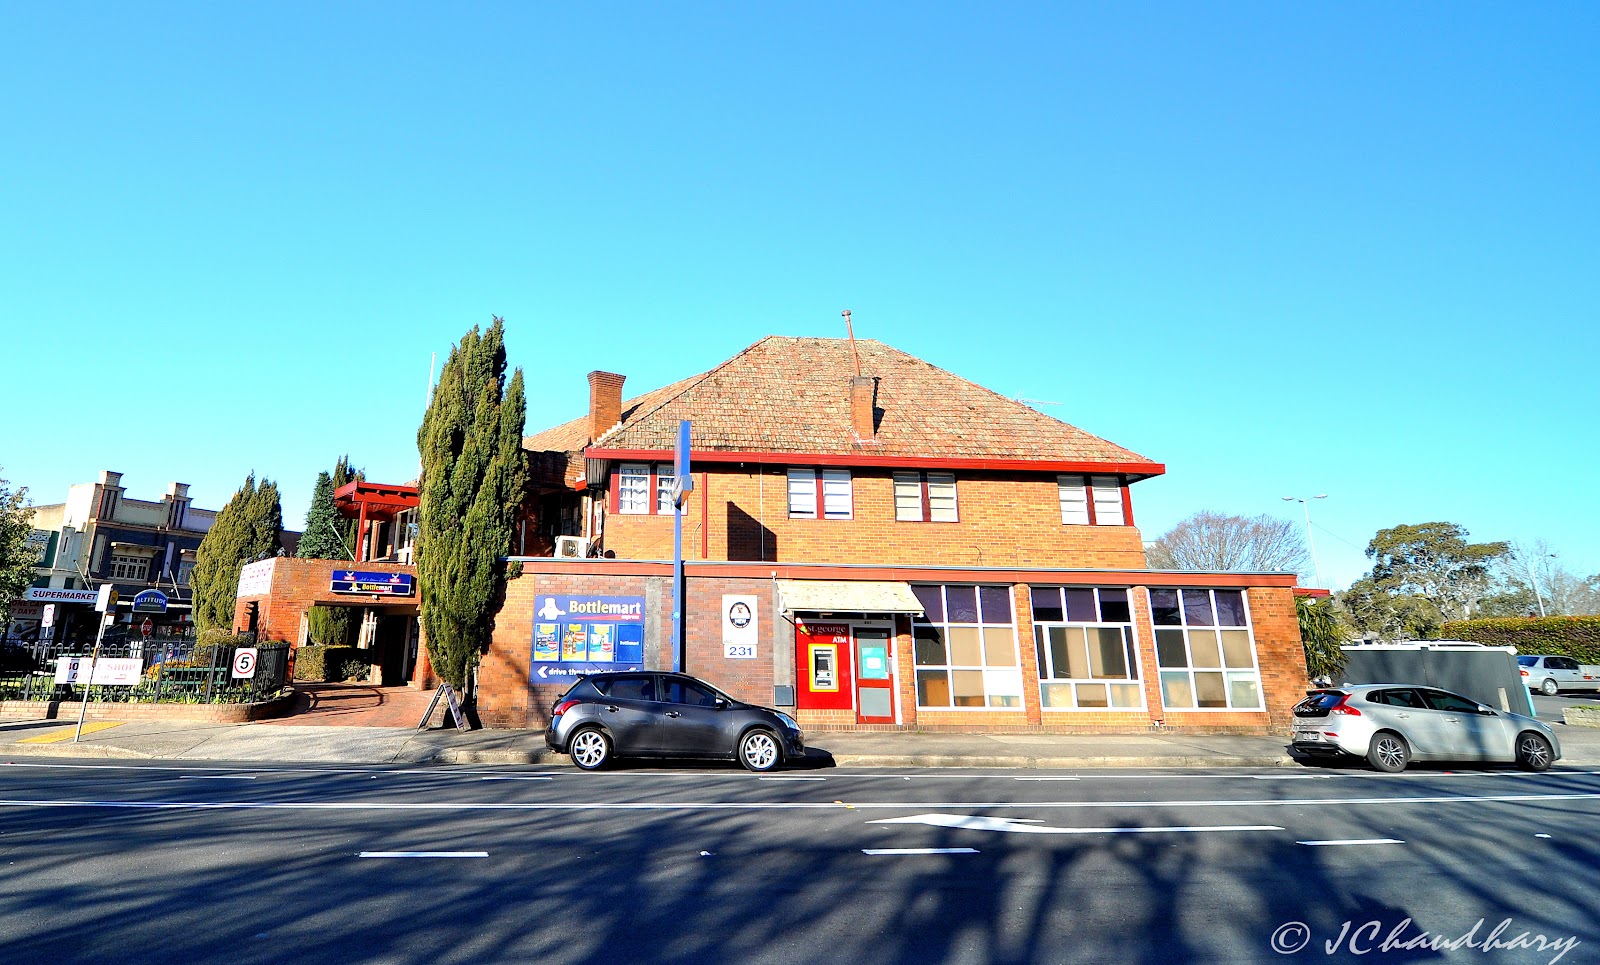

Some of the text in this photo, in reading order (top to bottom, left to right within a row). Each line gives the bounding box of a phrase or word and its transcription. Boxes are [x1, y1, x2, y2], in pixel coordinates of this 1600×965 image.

[361, 583, 393, 592] Bottlemart
[32, 590, 98, 600] SUPERMARKET
[136, 597, 167, 605] ALTITUDE
[569, 600, 641, 614] Bottlemart
[18, 608, 38, 616] DAYS
[729, 646, 752, 656] 231
[66, 662, 136, 671] BOTTE SHOP
[239, 656, 249, 670] 5
[548, 668, 567, 676] drive
